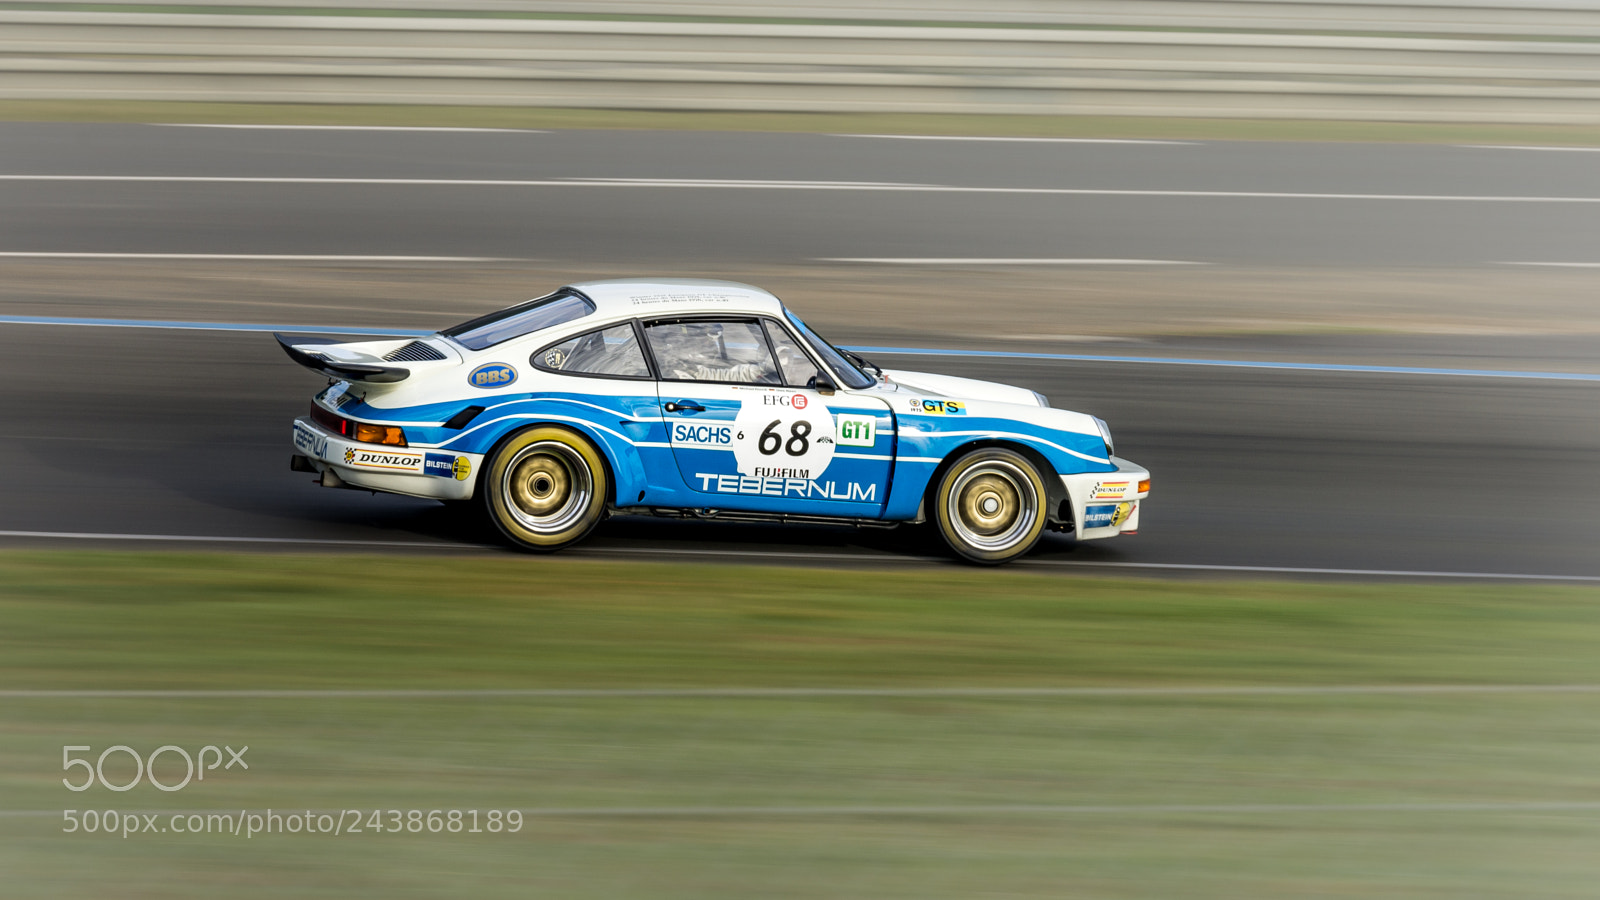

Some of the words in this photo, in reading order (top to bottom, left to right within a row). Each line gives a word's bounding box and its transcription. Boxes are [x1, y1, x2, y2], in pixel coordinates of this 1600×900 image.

[475, 368, 511, 385] BBS
[763, 394, 790, 406] EFG
[922, 399, 959, 413] GTS
[674, 425, 731, 444] SACHS
[736, 430, 745, 440] 6
[841, 420, 870, 440] GT1
[757, 418, 813, 457] 68
[359, 453, 421, 466] DUNLOP
[425, 460, 453, 470] BILSTEIN
[754, 466, 810, 479] FUJIFILM
[695, 472, 876, 501] TEBERNUM
[1085, 513, 1113, 521] BILSTEIN
